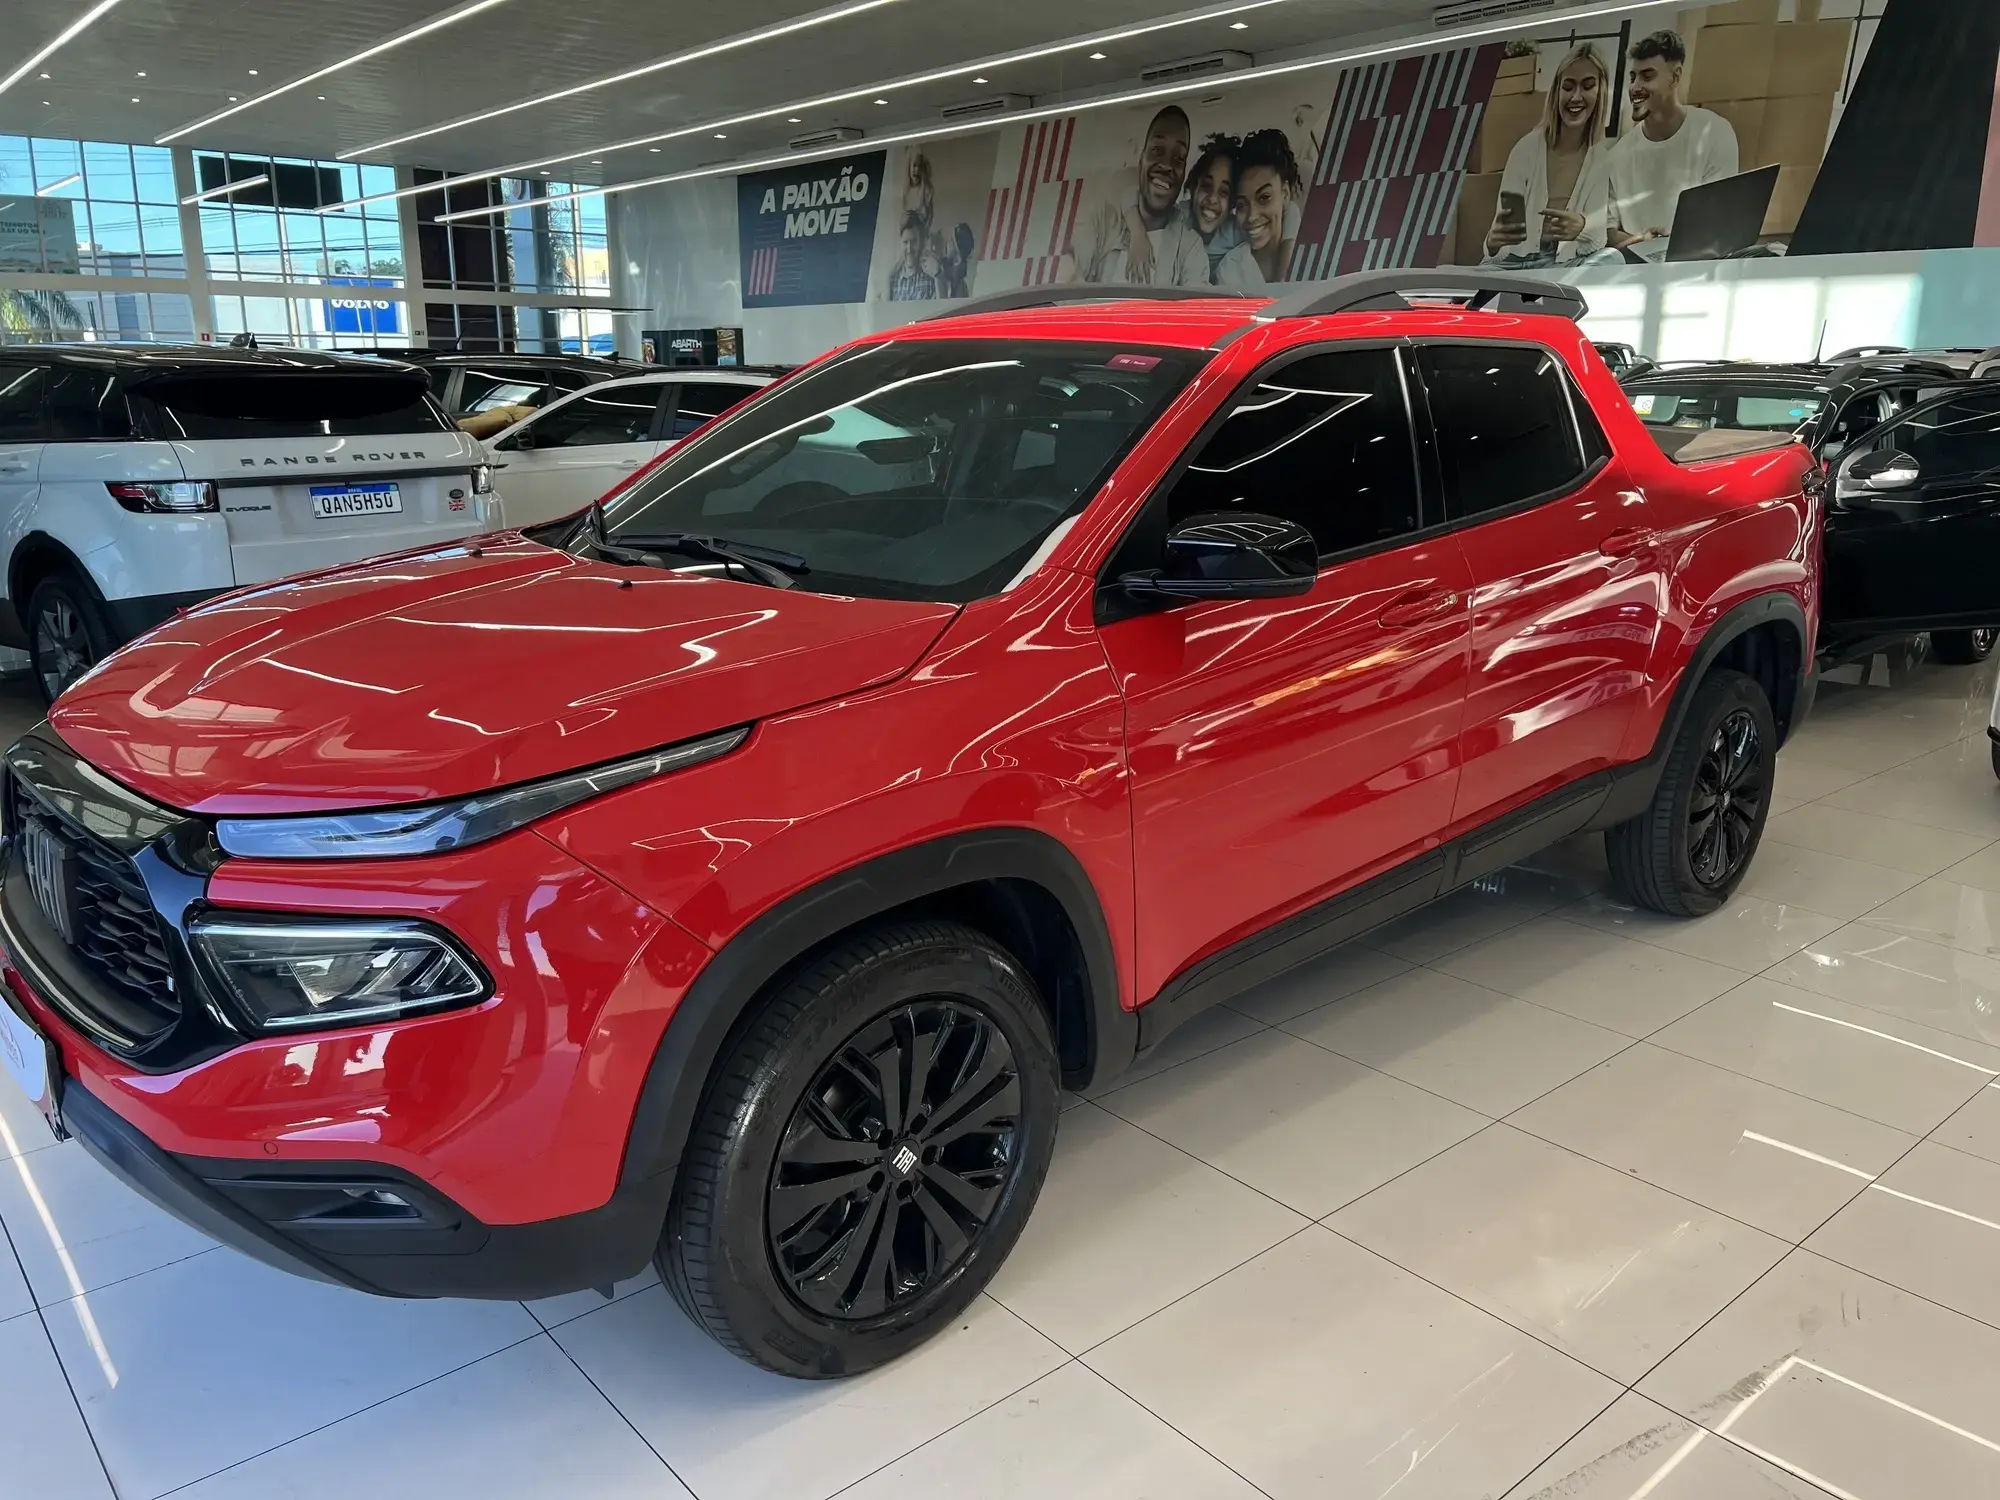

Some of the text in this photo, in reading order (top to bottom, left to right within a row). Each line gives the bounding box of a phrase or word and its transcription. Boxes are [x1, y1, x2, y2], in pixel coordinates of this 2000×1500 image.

[760, 165, 869, 214] A PAIXÃO
[783, 206, 851, 239] MOVE
[671, 339, 702, 349] ABARTH
[240, 451, 426, 467] RANGE ROVER
[225, 505, 272, 513] EVOQUE
[321, 492, 394, 514] QAN5H50
[892, 1145, 918, 1175] FIAT
